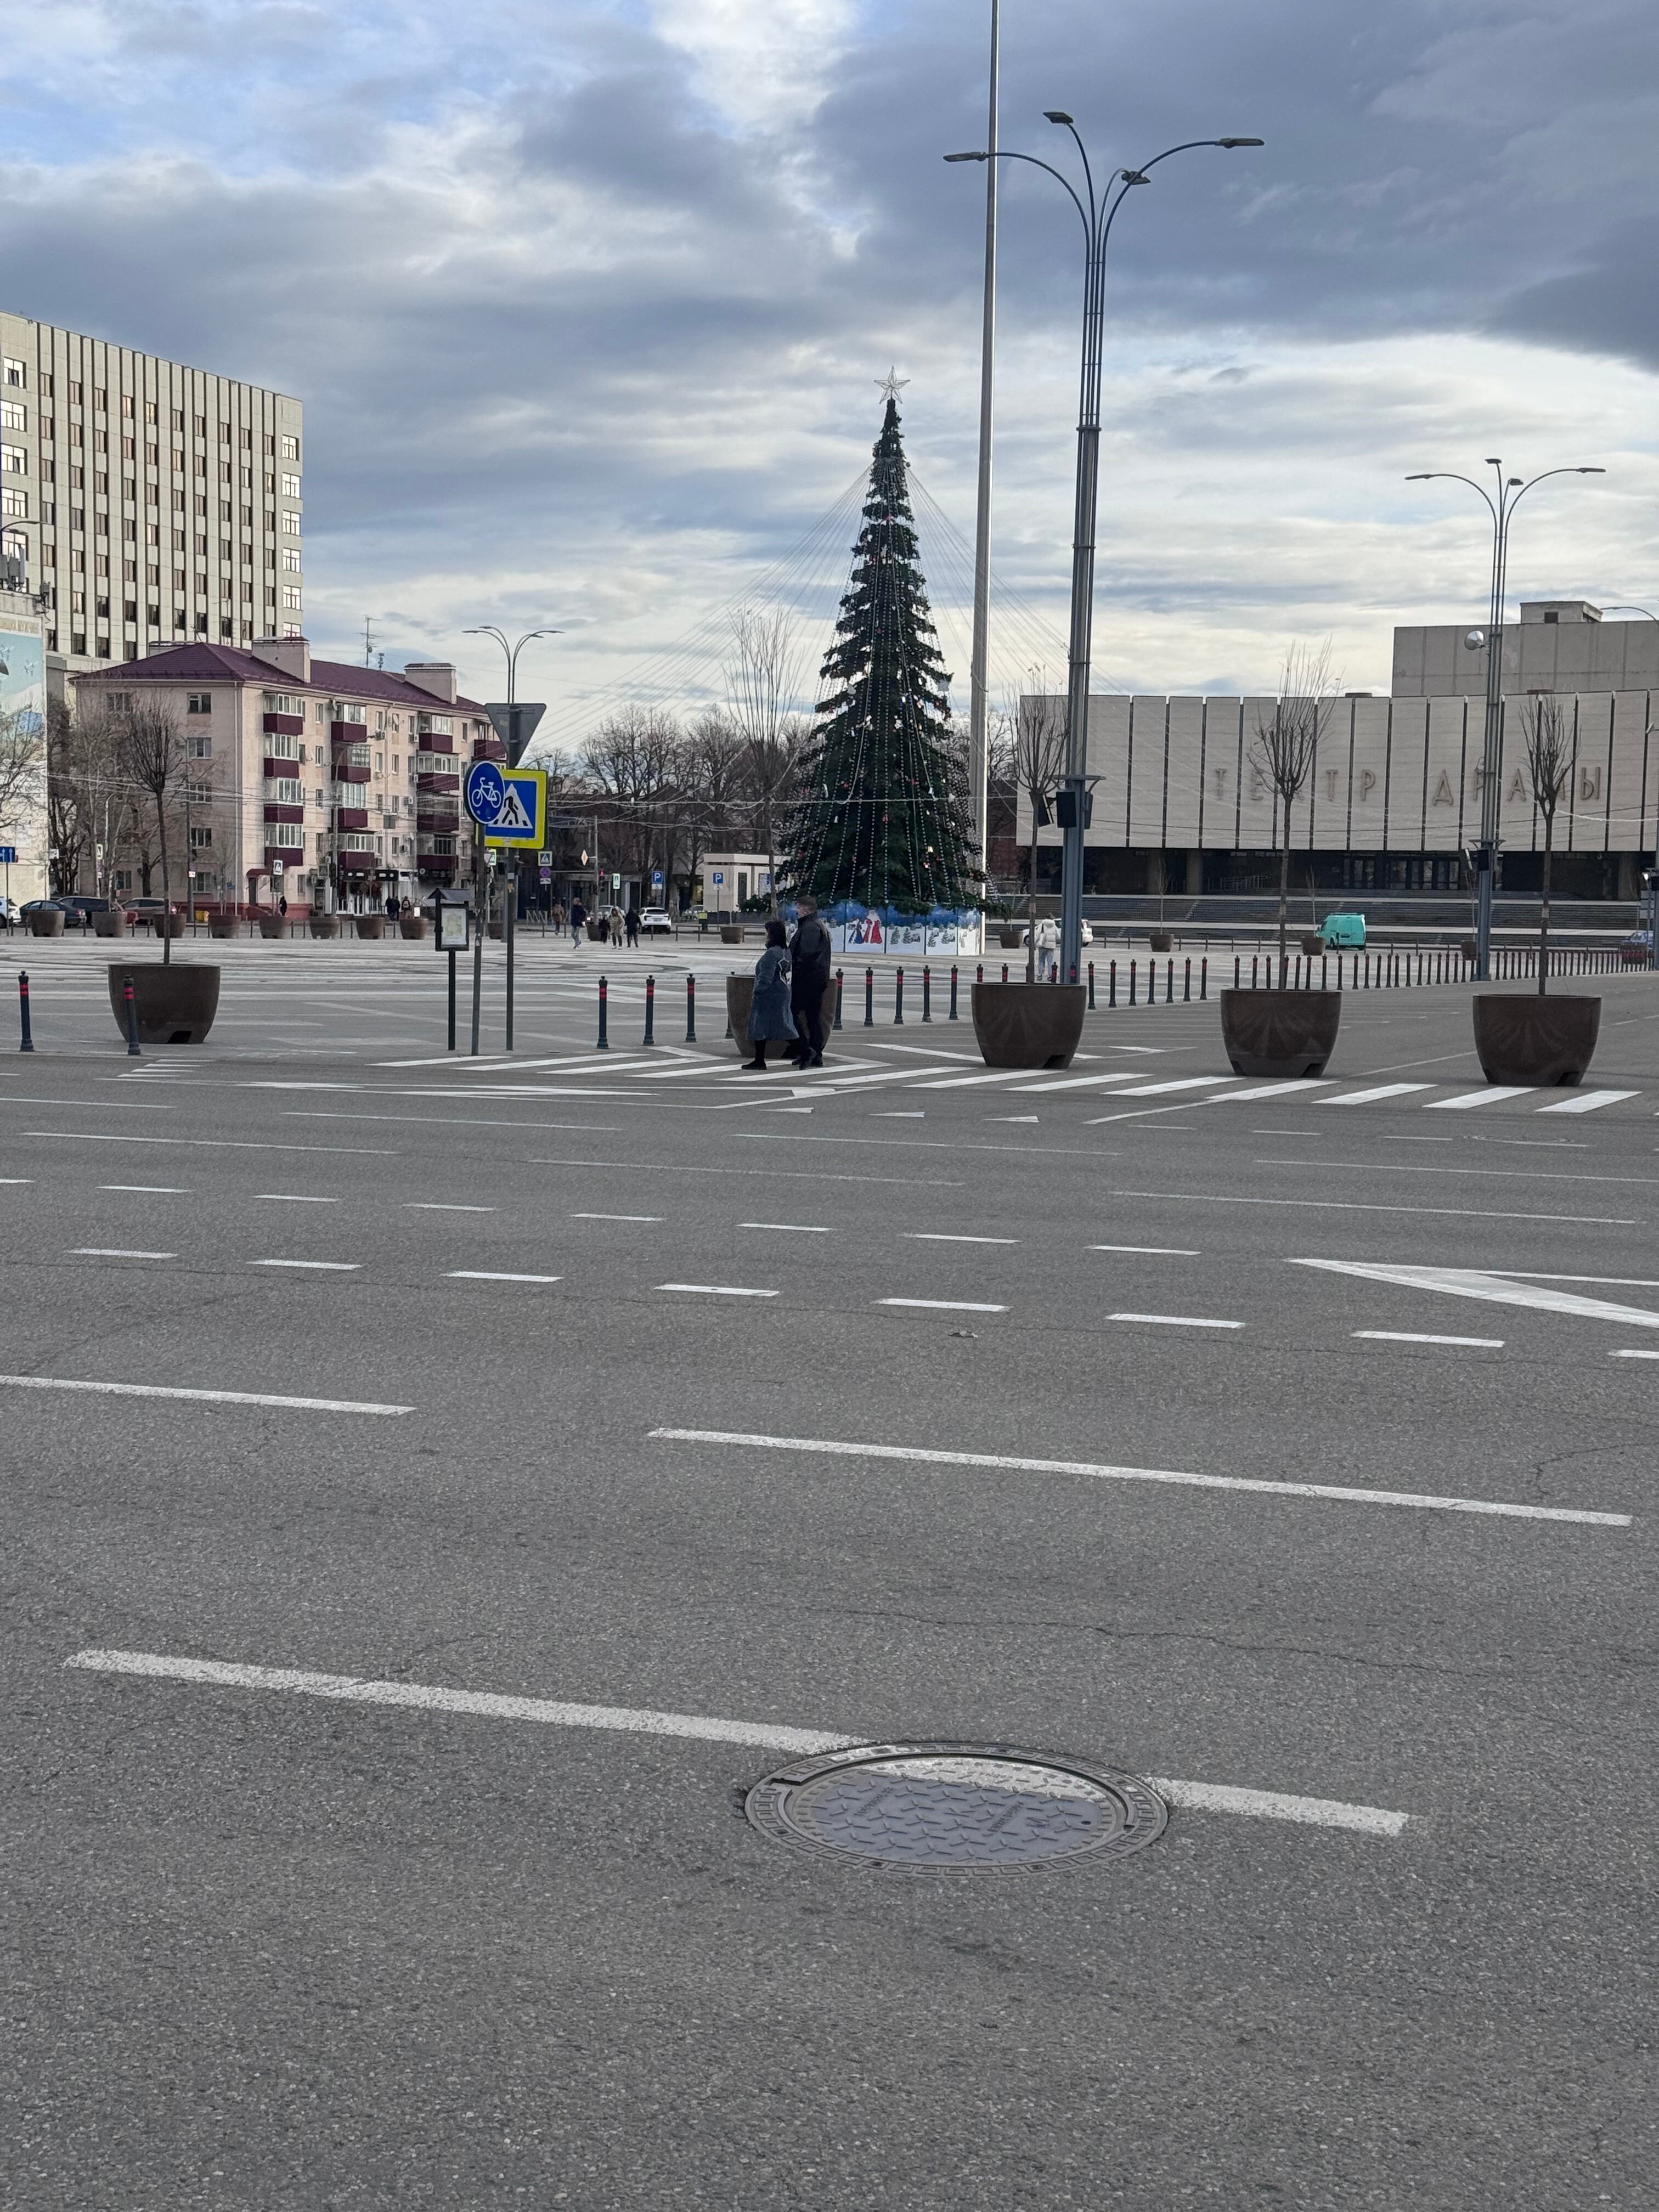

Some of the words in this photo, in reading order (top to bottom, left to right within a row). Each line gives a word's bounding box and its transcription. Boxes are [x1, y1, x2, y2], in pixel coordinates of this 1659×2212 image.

[1215, 768, 1376, 802] ТЕТР
[654, 872, 661, 881] P
[715, 873, 721, 883] P
